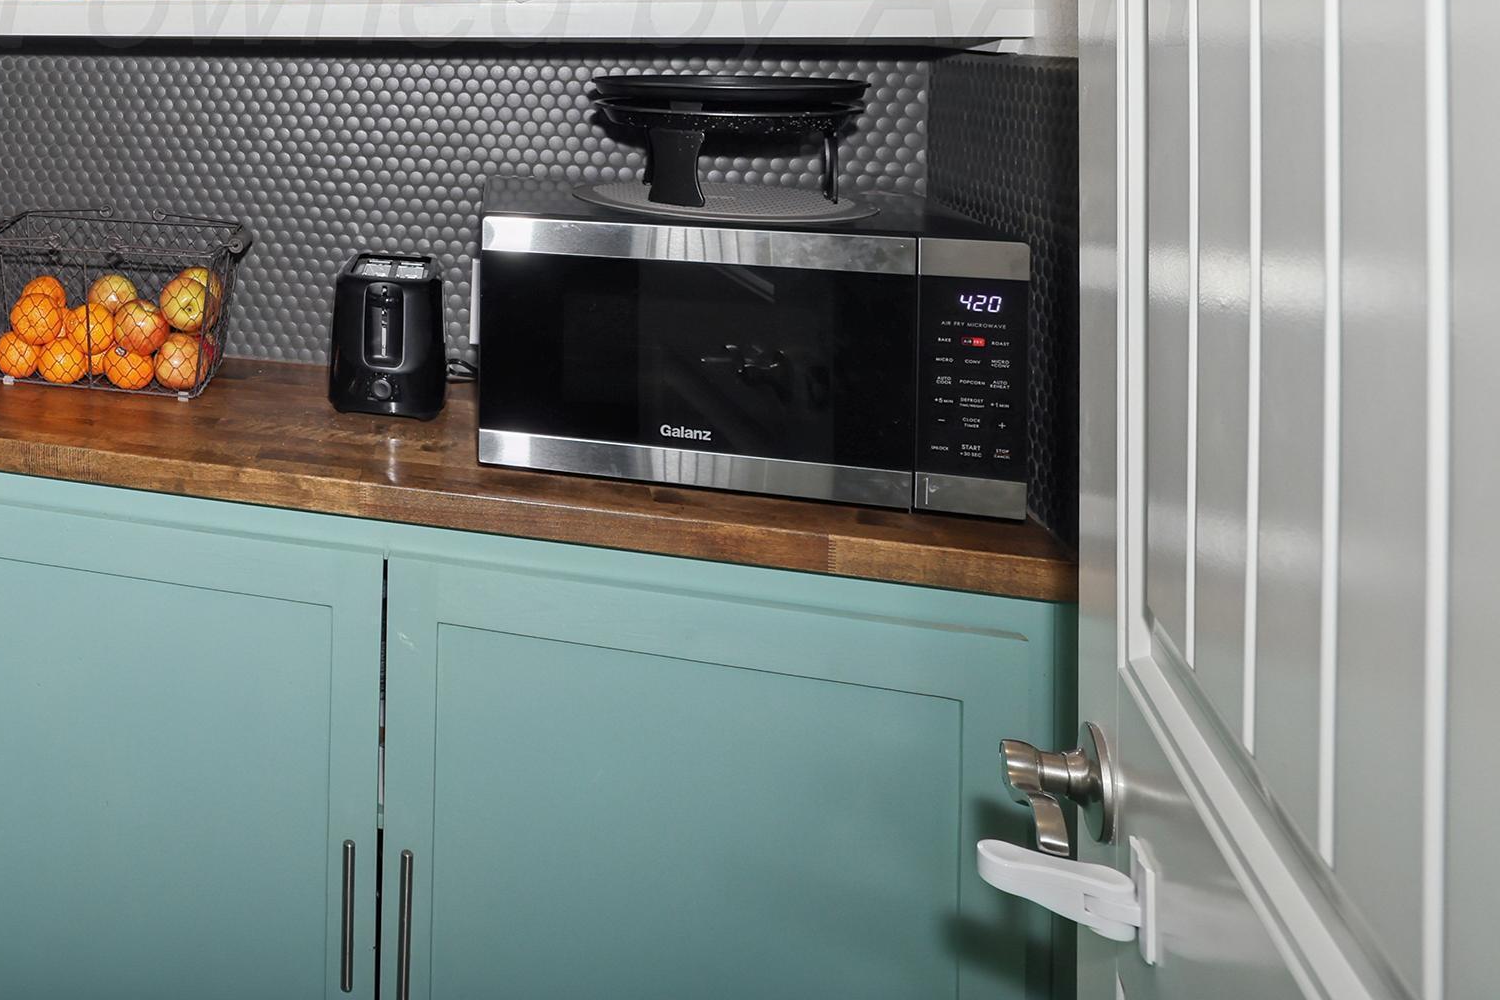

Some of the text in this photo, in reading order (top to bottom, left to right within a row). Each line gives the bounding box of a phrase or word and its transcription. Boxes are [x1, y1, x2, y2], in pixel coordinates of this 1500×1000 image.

[959, 294, 1003, 314] 420
[967, 322, 1007, 330] MICROWAVE
[660, 424, 712, 441] Galanz
